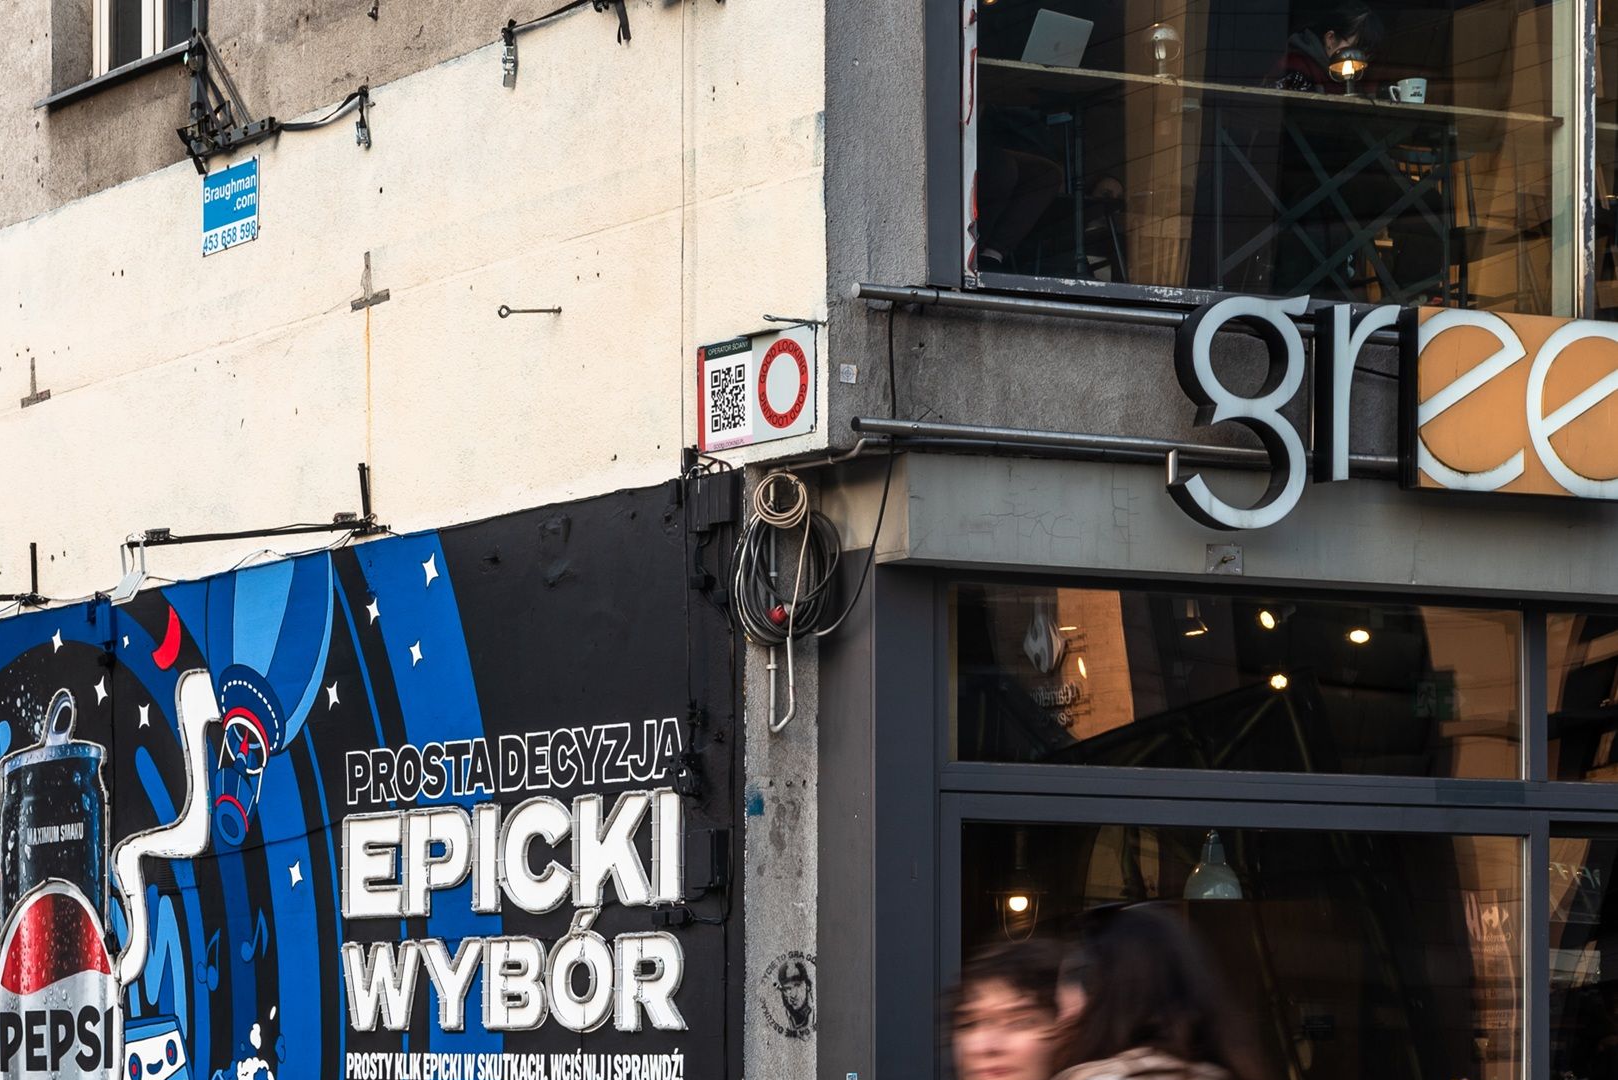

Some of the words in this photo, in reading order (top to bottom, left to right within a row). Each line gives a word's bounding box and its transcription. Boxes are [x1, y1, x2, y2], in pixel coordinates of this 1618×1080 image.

[204, 174, 257, 204] Braughman
[233, 192, 256, 212] .com
[203, 233, 219, 253] 453
[221, 226, 237, 246] 658
[240, 219, 257, 240] 598
[707, 344, 732, 356] OPERATOR
[759, 347, 777, 384] GOOD
[778, 340, 808, 376] LOOKING
[760, 391, 789, 426] LOOKING
[790, 383, 808, 420] GOOD
[345, 737, 491, 805] PROSTA
[498, 717, 686, 796] DECYZJA
[26, 826, 59, 845] MAXIMUM
[60, 822, 84, 842] SMAKU
[341, 786, 685, 919] EPICKI
[341, 907, 688, 1033] WYBÓR
[787, 950, 805, 960] GRA
[345, 1052, 394, 1080] PROSTY
[394, 1052, 422, 1080] KLIK
[423, 1052, 462, 1080] EPICKI
[463, 1053, 476, 1080] W
